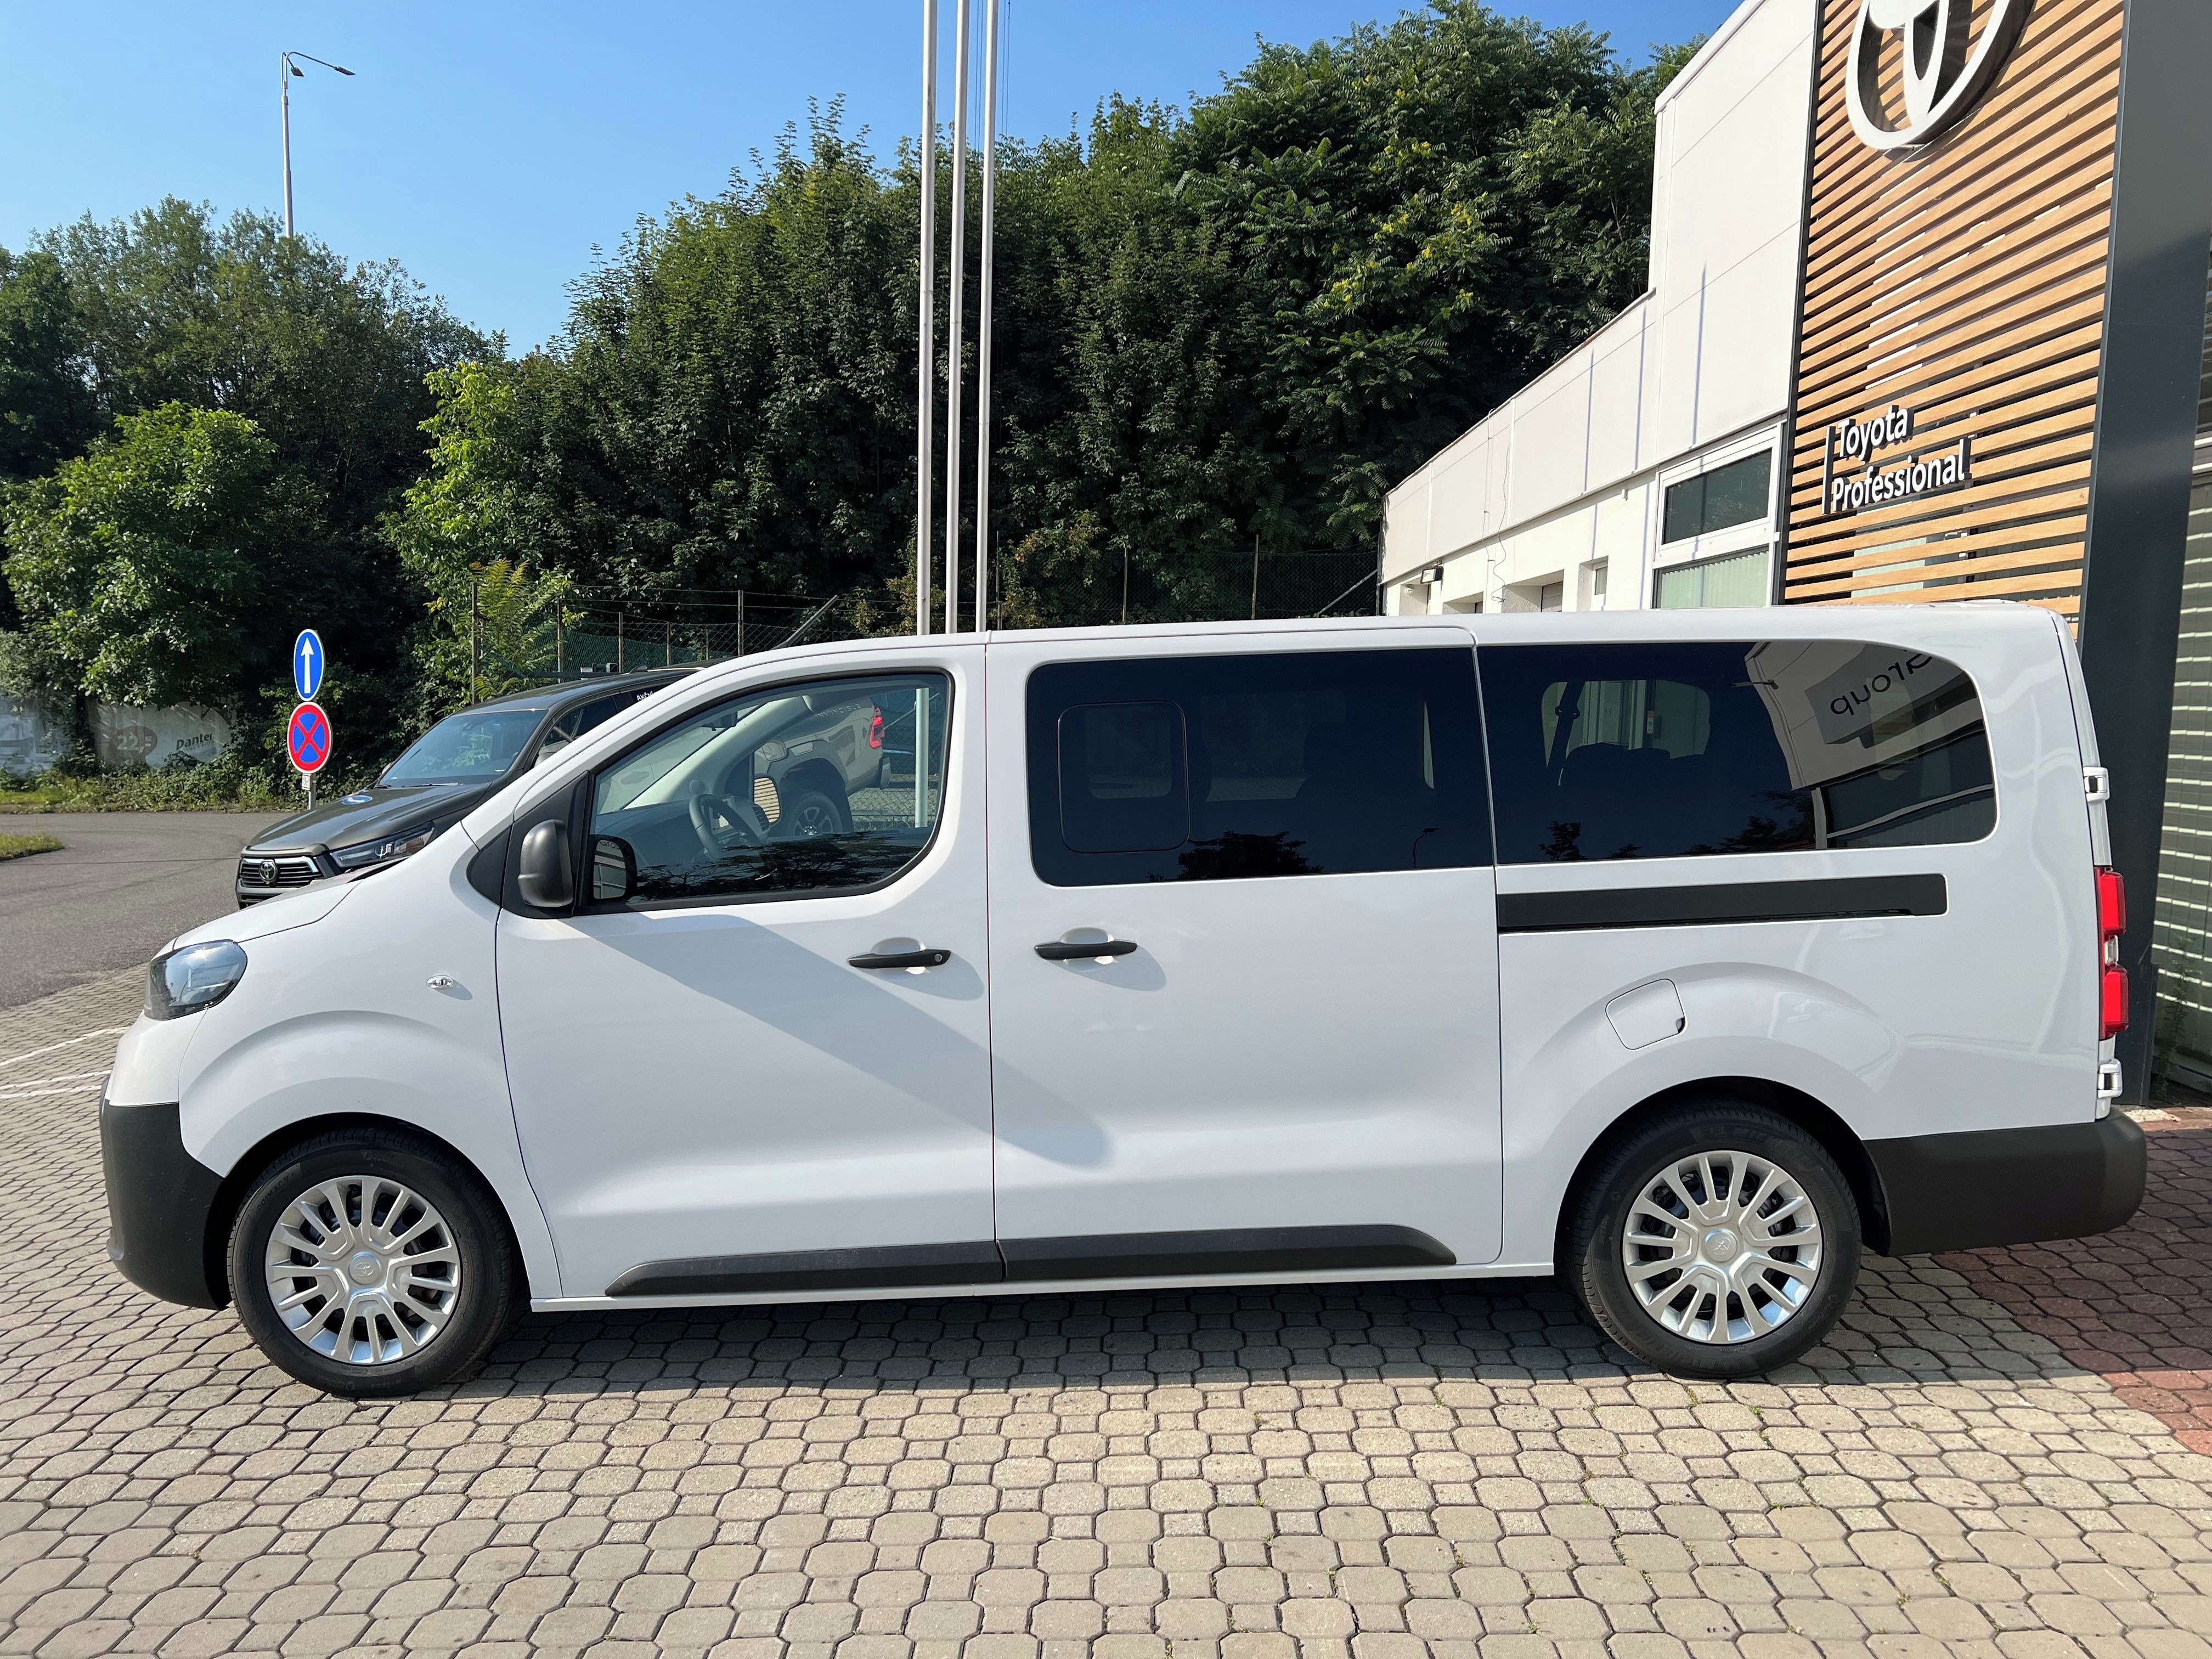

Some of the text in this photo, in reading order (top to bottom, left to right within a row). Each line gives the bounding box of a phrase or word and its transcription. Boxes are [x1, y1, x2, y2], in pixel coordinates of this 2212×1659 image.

[1838, 405, 1910, 461] Toyota
[1833, 439, 1966, 512] Professional
[815, 703, 861, 719] INVINCIBLE
